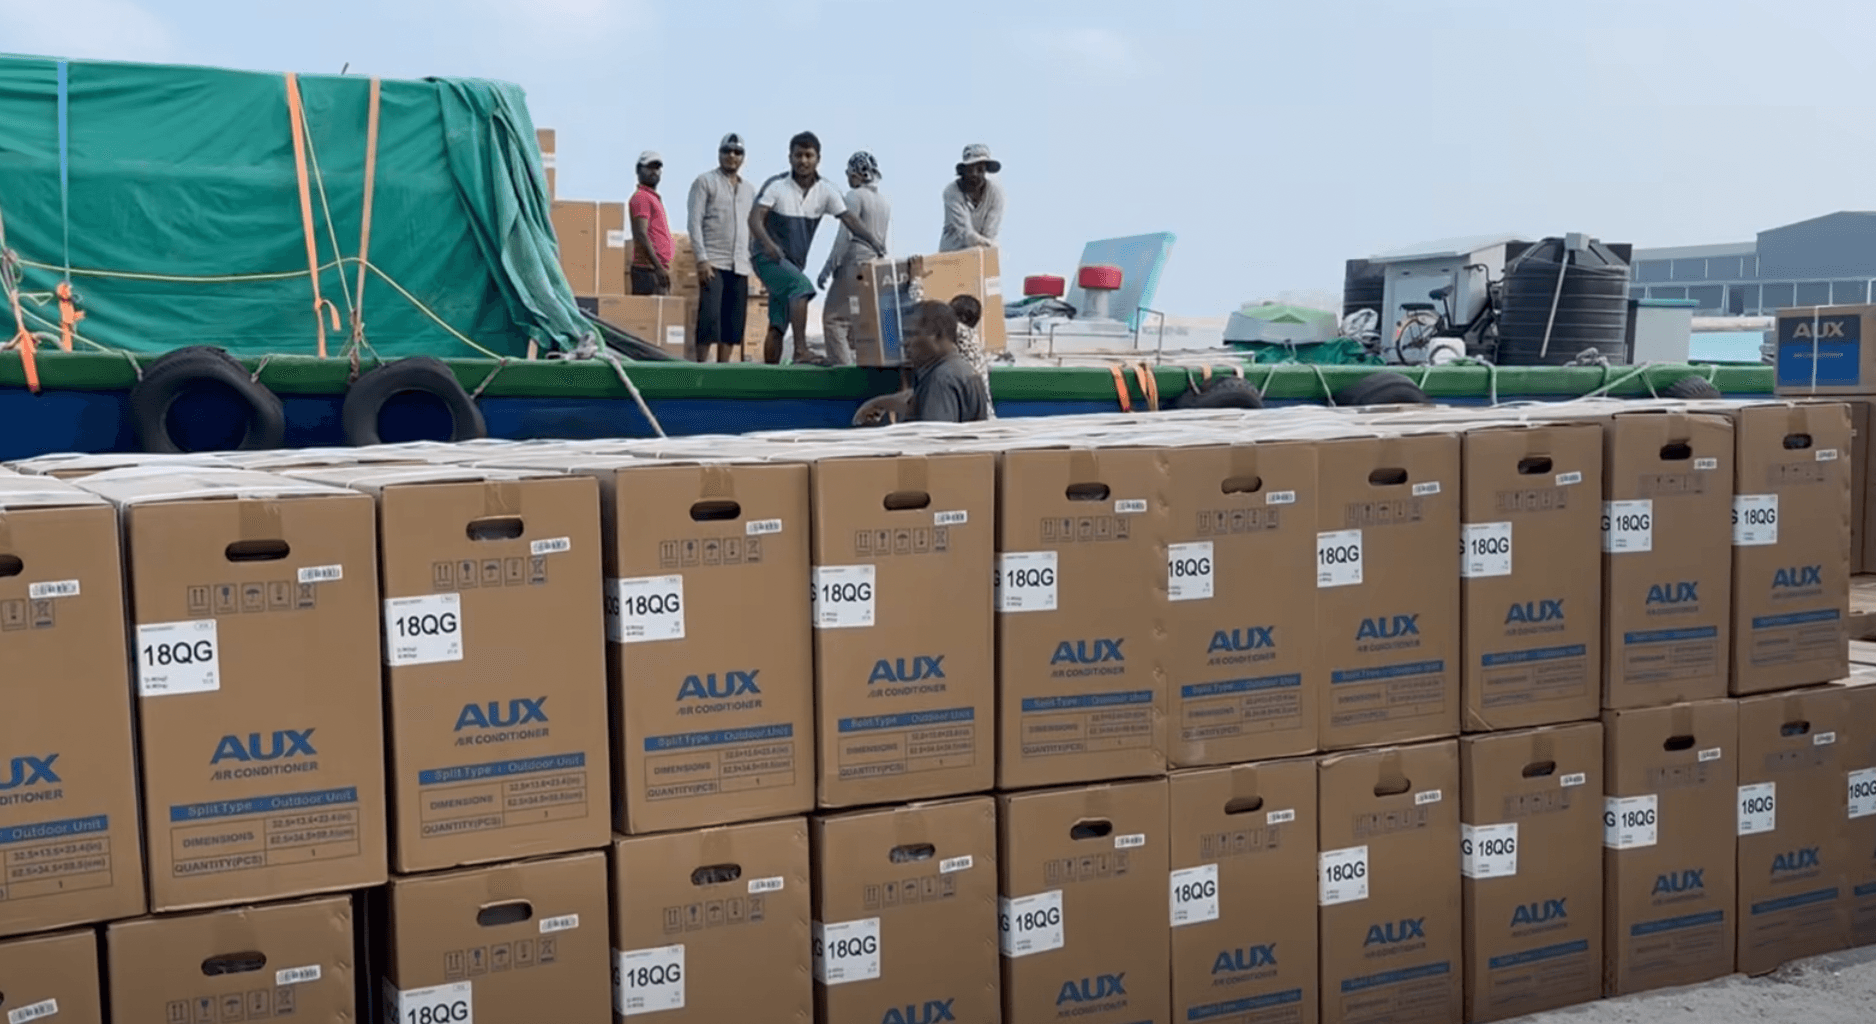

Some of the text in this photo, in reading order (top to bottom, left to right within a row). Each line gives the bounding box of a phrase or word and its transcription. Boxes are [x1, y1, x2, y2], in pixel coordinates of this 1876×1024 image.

[1792, 321, 1844, 338] AUX
[1616, 514, 1650, 532] 18QG
[1744, 508, 1776, 524] 18QG
[1318, 545, 1359, 564] 18QG
[1471, 537, 1509, 555] 18QG
[1006, 568, 1054, 588] 18QG
[1168, 558, 1210, 578] 18QG
[1772, 564, 1822, 588] AUX
[822, 582, 872, 602] 18QG
[1646, 582, 1698, 604] AUX
[626, 593, 680, 616] 18QG
[1504, 598, 1564, 625] AUX
[396, 612, 456, 637] 18QG
[1356, 614, 1420, 641] AUX
[1207, 626, 1276, 654] AUX
[144, 640, 212, 666] 18QG
[1050, 638, 1124, 665] AUX
[868, 655, 946, 684] AUX
[676, 669, 760, 702] AUX
[884, 684, 946, 697] CONDITIONER
[454, 696, 548, 732] AUX
[694, 700, 762, 714] CONDITIONER
[210, 728, 317, 764] AUX
[476, 728, 549, 744] CONDITIONER
[684, 733, 710, 746] Type
[724, 728, 764, 740] Outdoor
[0, 754, 62, 790] UX
[210, 762, 318, 781] AIR CONDITIONER
[434, 770, 461, 780] Split
[464, 766, 491, 778] Type
[508, 760, 553, 772] Outdoor
[557, 756, 579, 767] Unit
[654, 762, 712, 774] DIMENSIONS
[0, 790, 62, 805] DITIONER
[648, 784, 717, 798] QUANTITY(PCS)
[1849, 780, 1876, 799] 18QG
[188, 806, 218, 817] Split
[222, 802, 252, 815] Type
[271, 795, 322, 808] Outdoor
[327, 791, 352, 802] Unit
[430, 795, 493, 810] DIMENSIONS
[1742, 796, 1774, 815] 18QG
[12, 818, 100, 839] Outdoor Unit
[423, 818, 500, 834] QUANTITY(PCS)
[1622, 809, 1655, 828] 18QG
[183, 832, 254, 848] DIMENSIONS
[1478, 838, 1514, 857] 18QG
[175, 856, 262, 873] QUANTITY(PCS)
[1326, 860, 1366, 882] 18QG
[1770, 846, 1820, 874] AUX
[1174, 880, 1216, 903] 18QG
[1651, 868, 1705, 896] AUX
[1016, 907, 1060, 932] 18QG
[1510, 898, 1567, 928] AUX
[1363, 916, 1426, 947] AUX
[828, 935, 876, 960] 18QG
[1211, 942, 1277, 974] AUX
[627, 964, 680, 988] 18QG
[1056, 972, 1127, 1006] AUX
[408, 1001, 468, 1024] 18QG
[882, 998, 956, 1024] AUX
